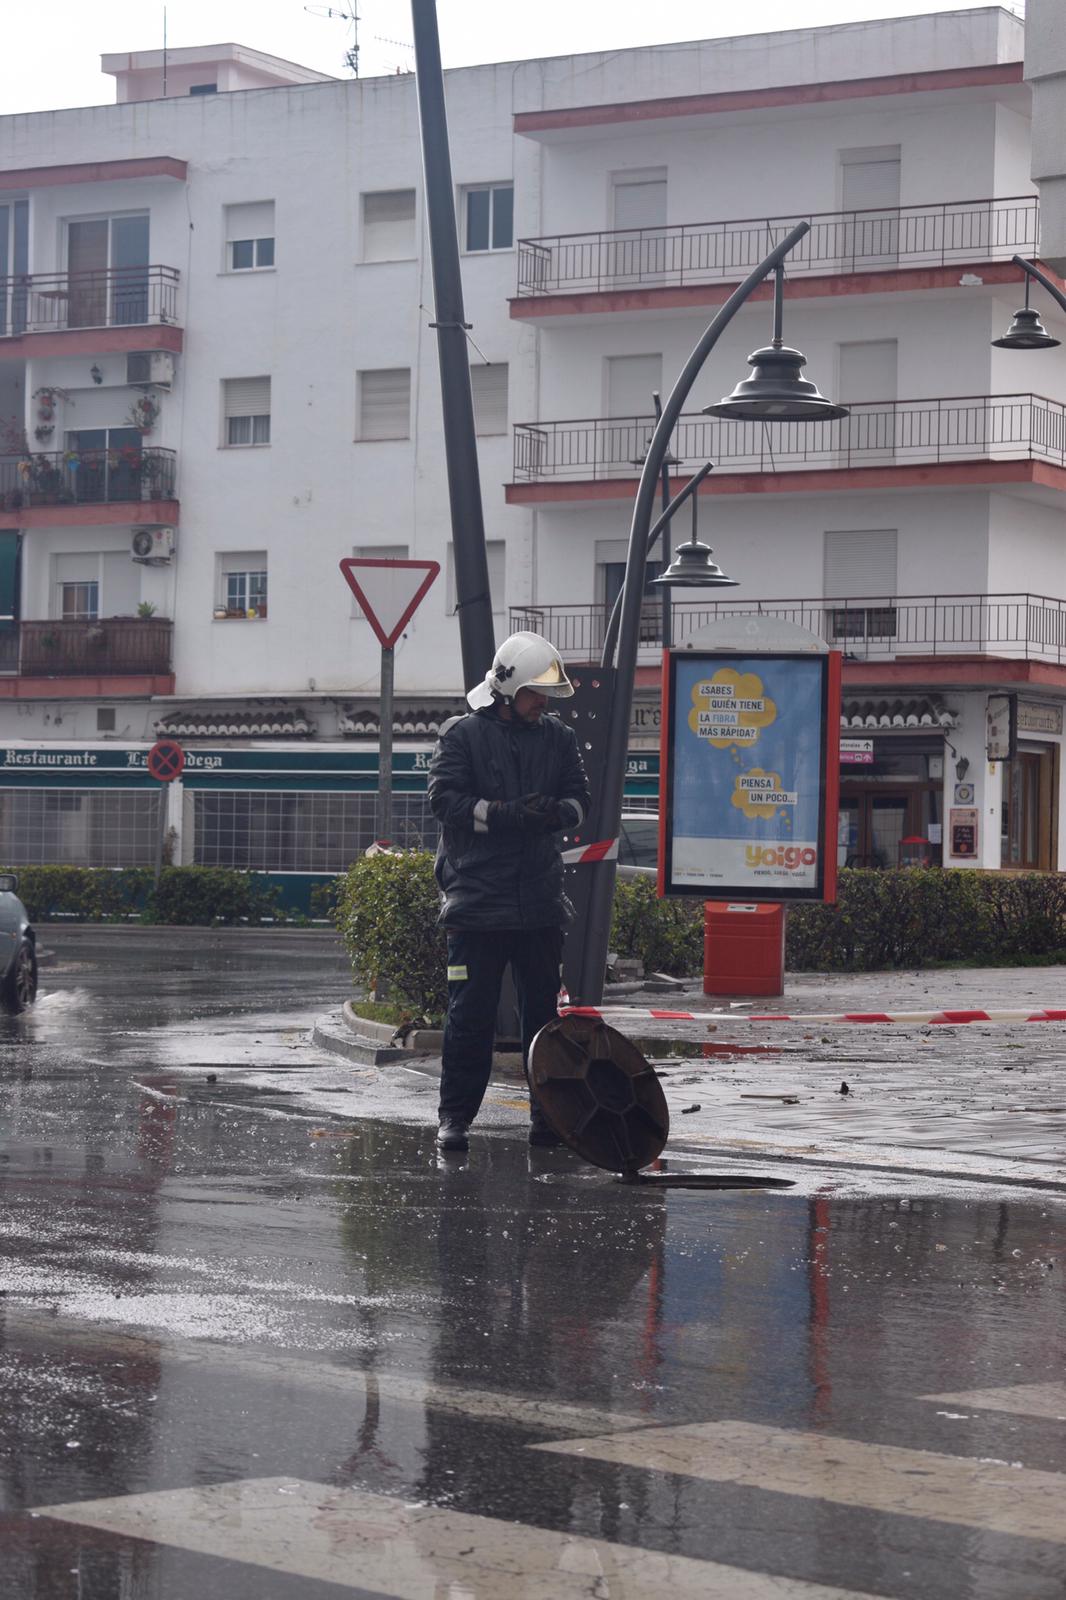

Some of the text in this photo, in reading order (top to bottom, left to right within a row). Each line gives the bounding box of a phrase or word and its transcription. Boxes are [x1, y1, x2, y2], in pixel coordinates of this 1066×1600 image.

[700, 685, 732, 696] ¿SABES
[711, 698, 763, 710] QUIÉN TIENE
[700, 713, 736, 723] LA FIBRA
[699, 726, 756, 738] MÁS RÁPIDA?
[4, 749, 97, 767] Restaurante
[741, 778, 772, 788] PIENSA
[751, 792, 763, 802] UN
[744, 844, 817, 870] yoigo
